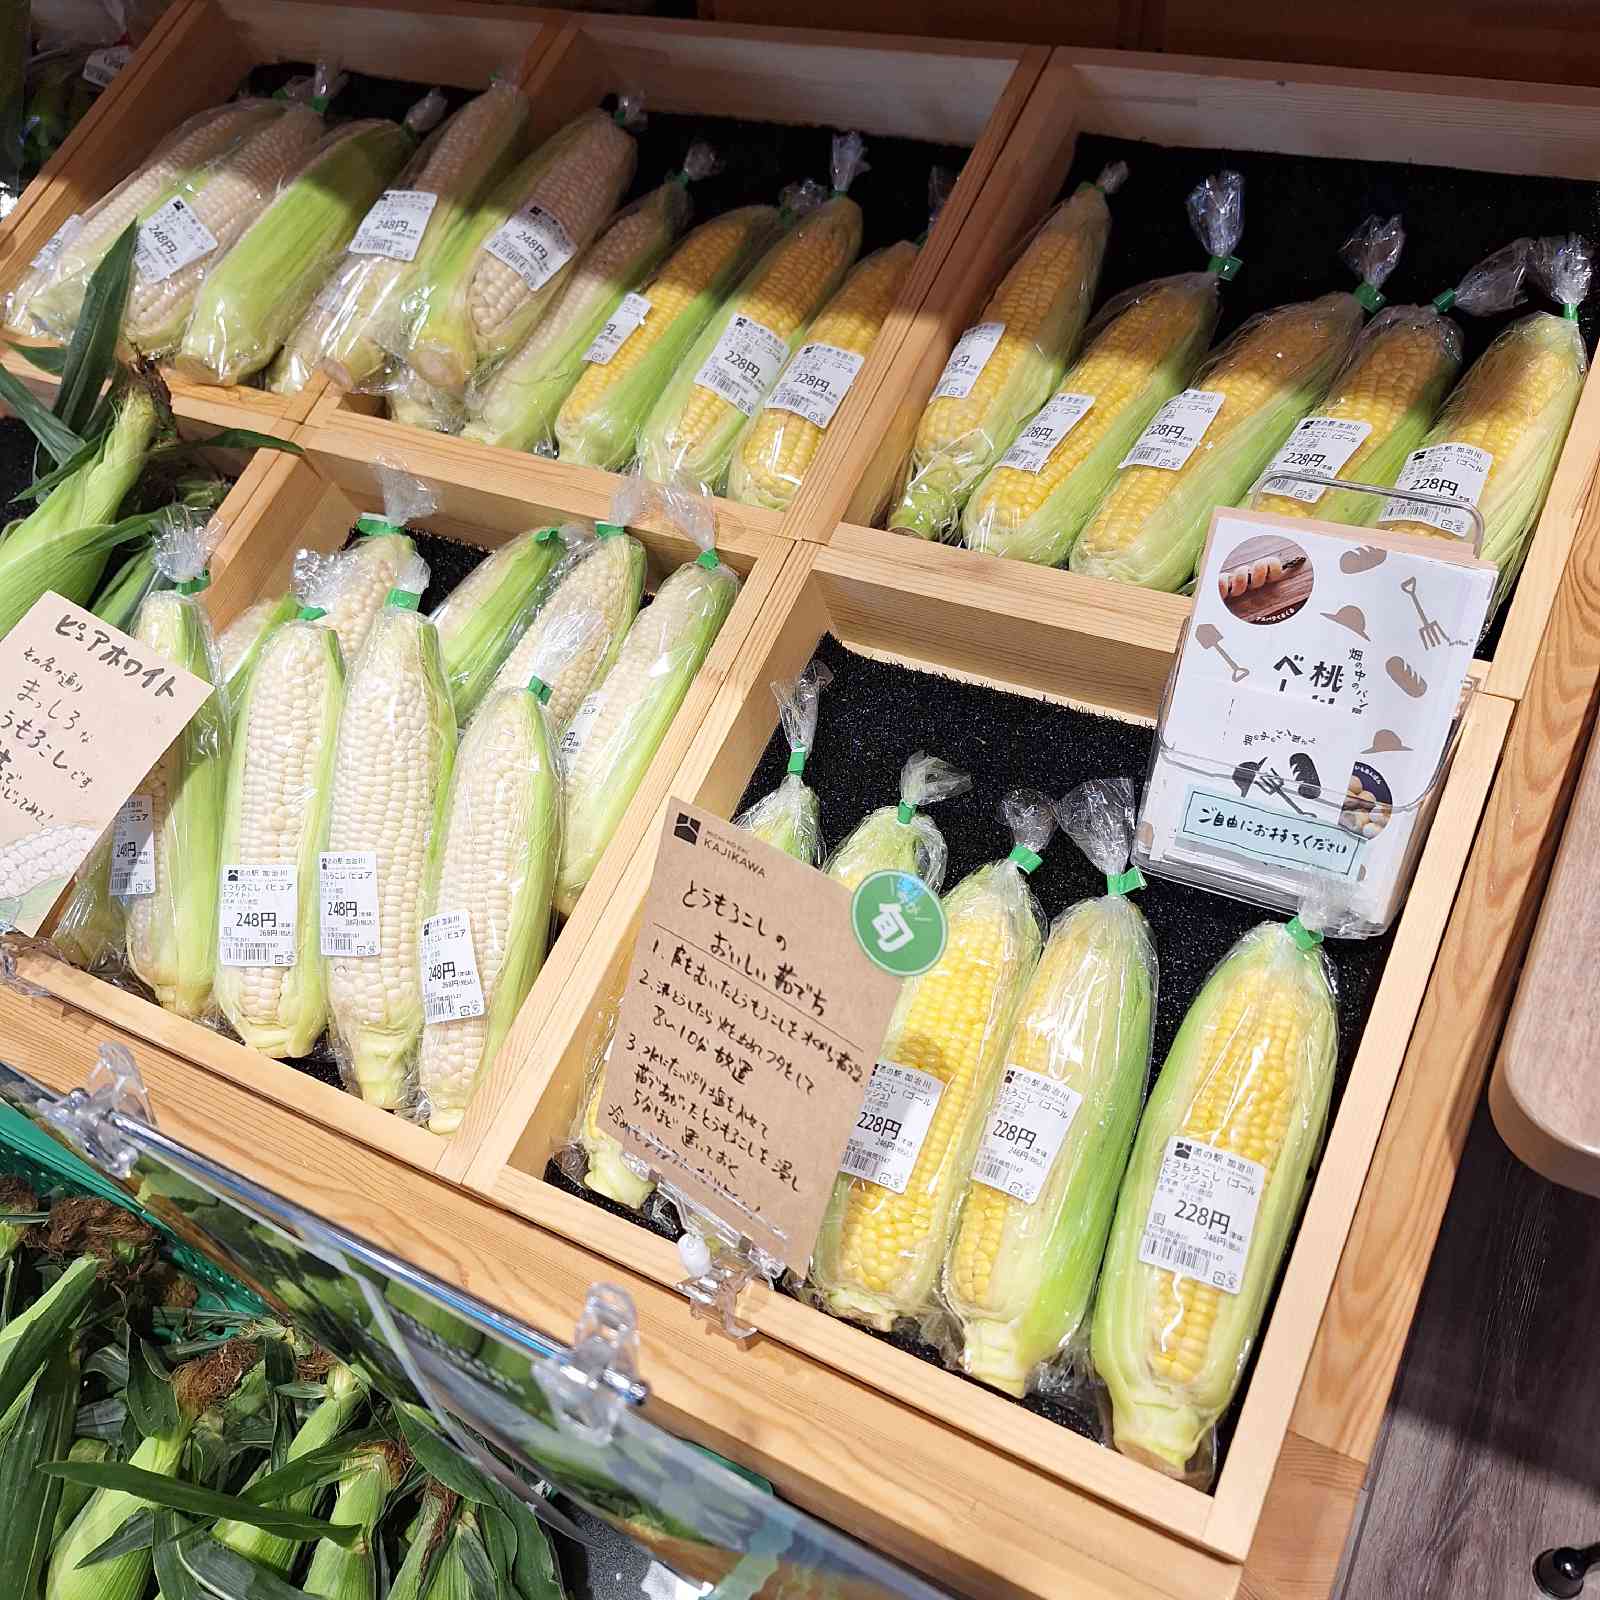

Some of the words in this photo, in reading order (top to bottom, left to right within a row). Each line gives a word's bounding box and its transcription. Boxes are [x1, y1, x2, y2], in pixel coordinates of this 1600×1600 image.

[148, 225, 178, 255] 248円
[515, 231, 548, 260] 248円
[724, 350, 760, 379] 228円
[793, 373, 830, 393] 228円
[1283, 452, 1326, 467] 228円
[1409, 478, 1459, 496] 228円
[24, 646, 83, 692] その名の通り
[55, 614, 175, 698] ピュアホワイト
[17, 680, 89, 743] まっしろな
[1199, 807, 1347, 853] ご自由にお持ちください
[704, 838, 765, 878] KAJIKAWA
[236, 912, 277, 928] 248円
[328, 901, 357, 918] 248円
[682, 879, 787, 951] とうもろこしの
[857, 1111, 903, 1140] 228円
[993, 1119, 1037, 1150] 228円
[1174, 1200, 1231, 1235] 228円
